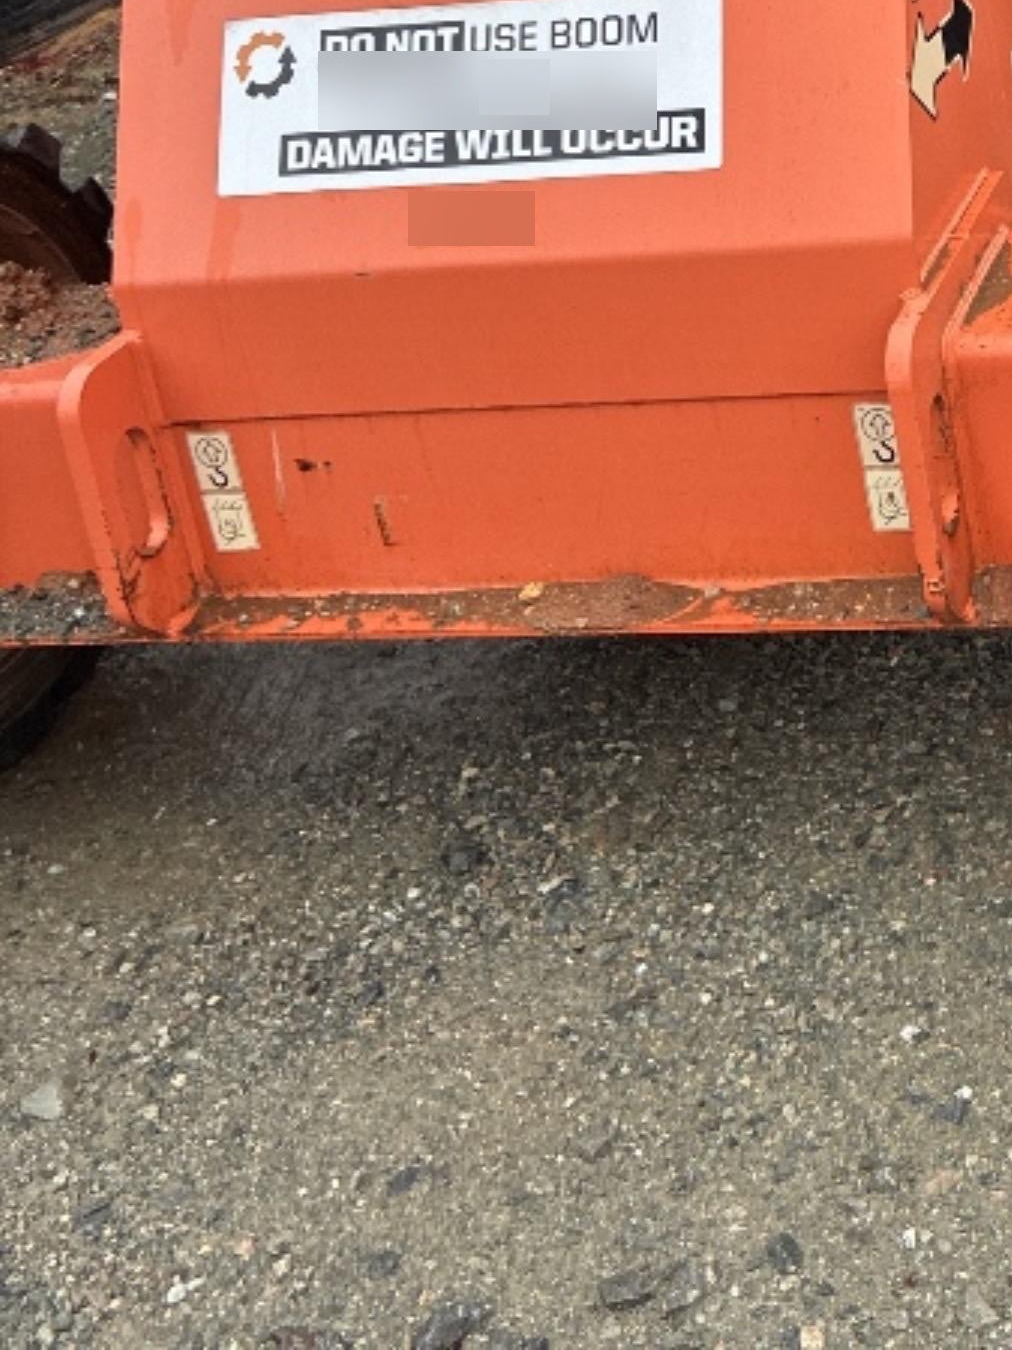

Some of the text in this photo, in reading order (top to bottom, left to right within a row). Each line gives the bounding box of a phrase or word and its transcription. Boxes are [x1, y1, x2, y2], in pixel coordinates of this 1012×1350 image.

[470, 21, 538, 51] USE
[551, 11, 658, 49] BOOM
[286, 116, 699, 171] DAMAGE WILL OCCUR
